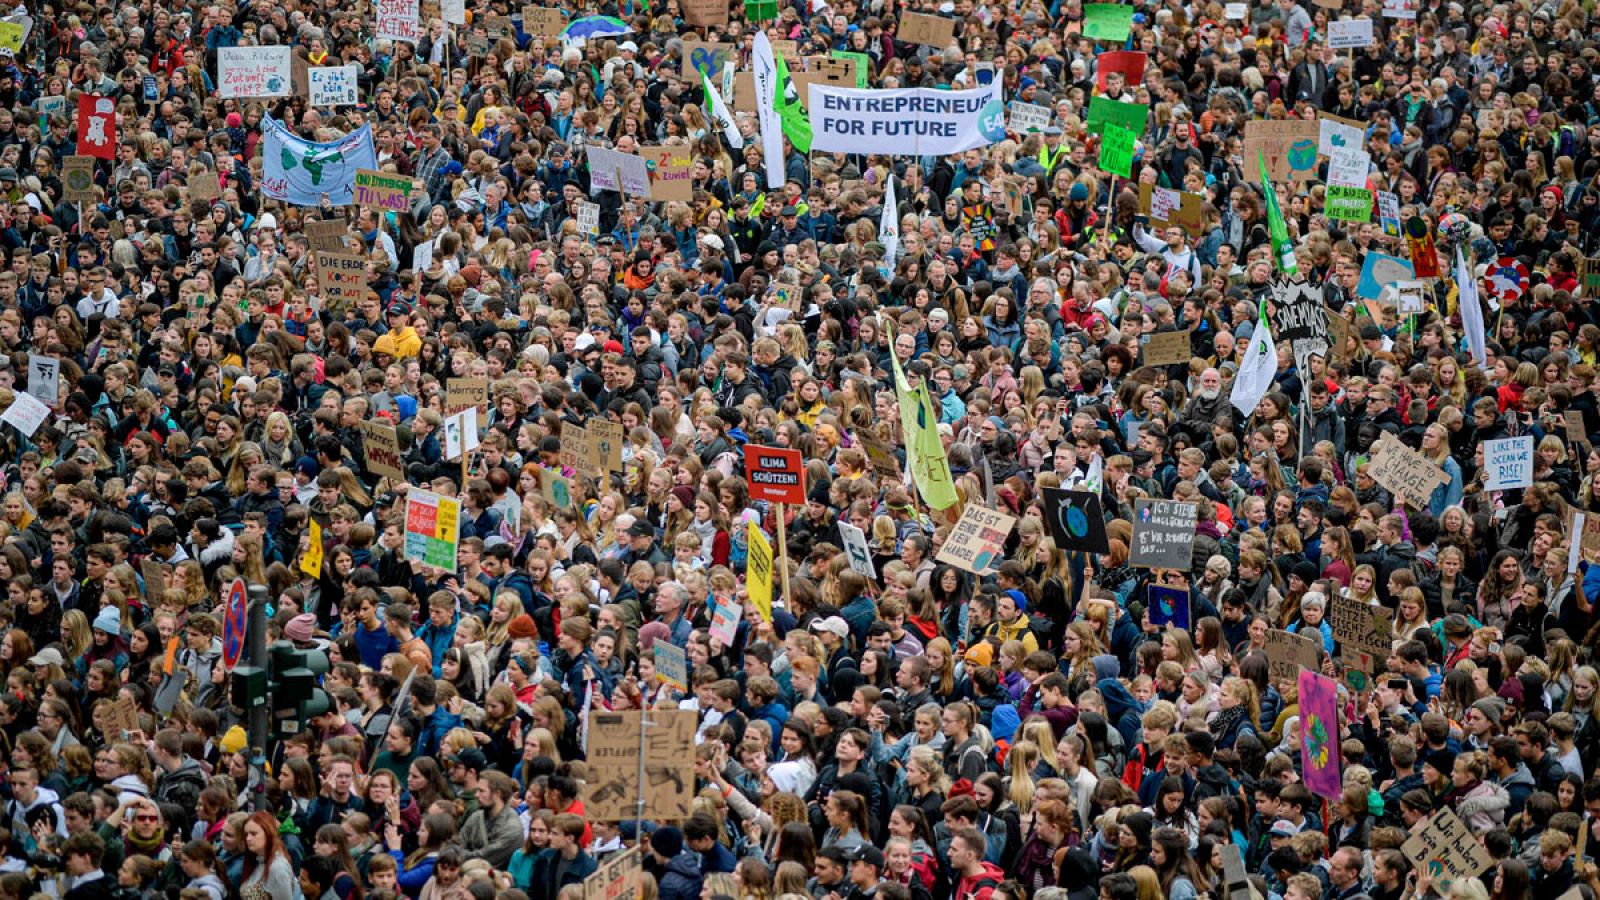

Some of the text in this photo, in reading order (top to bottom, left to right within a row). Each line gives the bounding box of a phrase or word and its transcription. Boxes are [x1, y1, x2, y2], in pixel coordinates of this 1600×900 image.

[379, 18, 416, 37] ACTING
[312, 71, 345, 84] Es gibt
[314, 89, 355, 104] Planet B
[823, 118, 957, 136] FOR FUTURE
[357, 187, 409, 212] TU WAS!
[319, 256, 364, 270] DIE ERDE
[325, 287, 361, 299] VOR WUT
[1493, 440, 1525, 453] LIKE THE
[760, 457, 786, 468] KLIMA
[1492, 452, 1528, 464] OCEAN WE
[752, 471, 797, 484] SCHÜTZEN!
[1384, 458, 1427, 492] CHANGE
[1424, 466, 1436, 478] TO
[1500, 463, 1523, 478] RISE!
[1153, 502, 1170, 514] ICH
[965, 507, 1001, 526] DAS IST
[943, 543, 974, 562] HANDEL
[1420, 826, 1437, 850] kein
[1434, 811, 1479, 870] Wir haben
[1415, 847, 1429, 862] B
